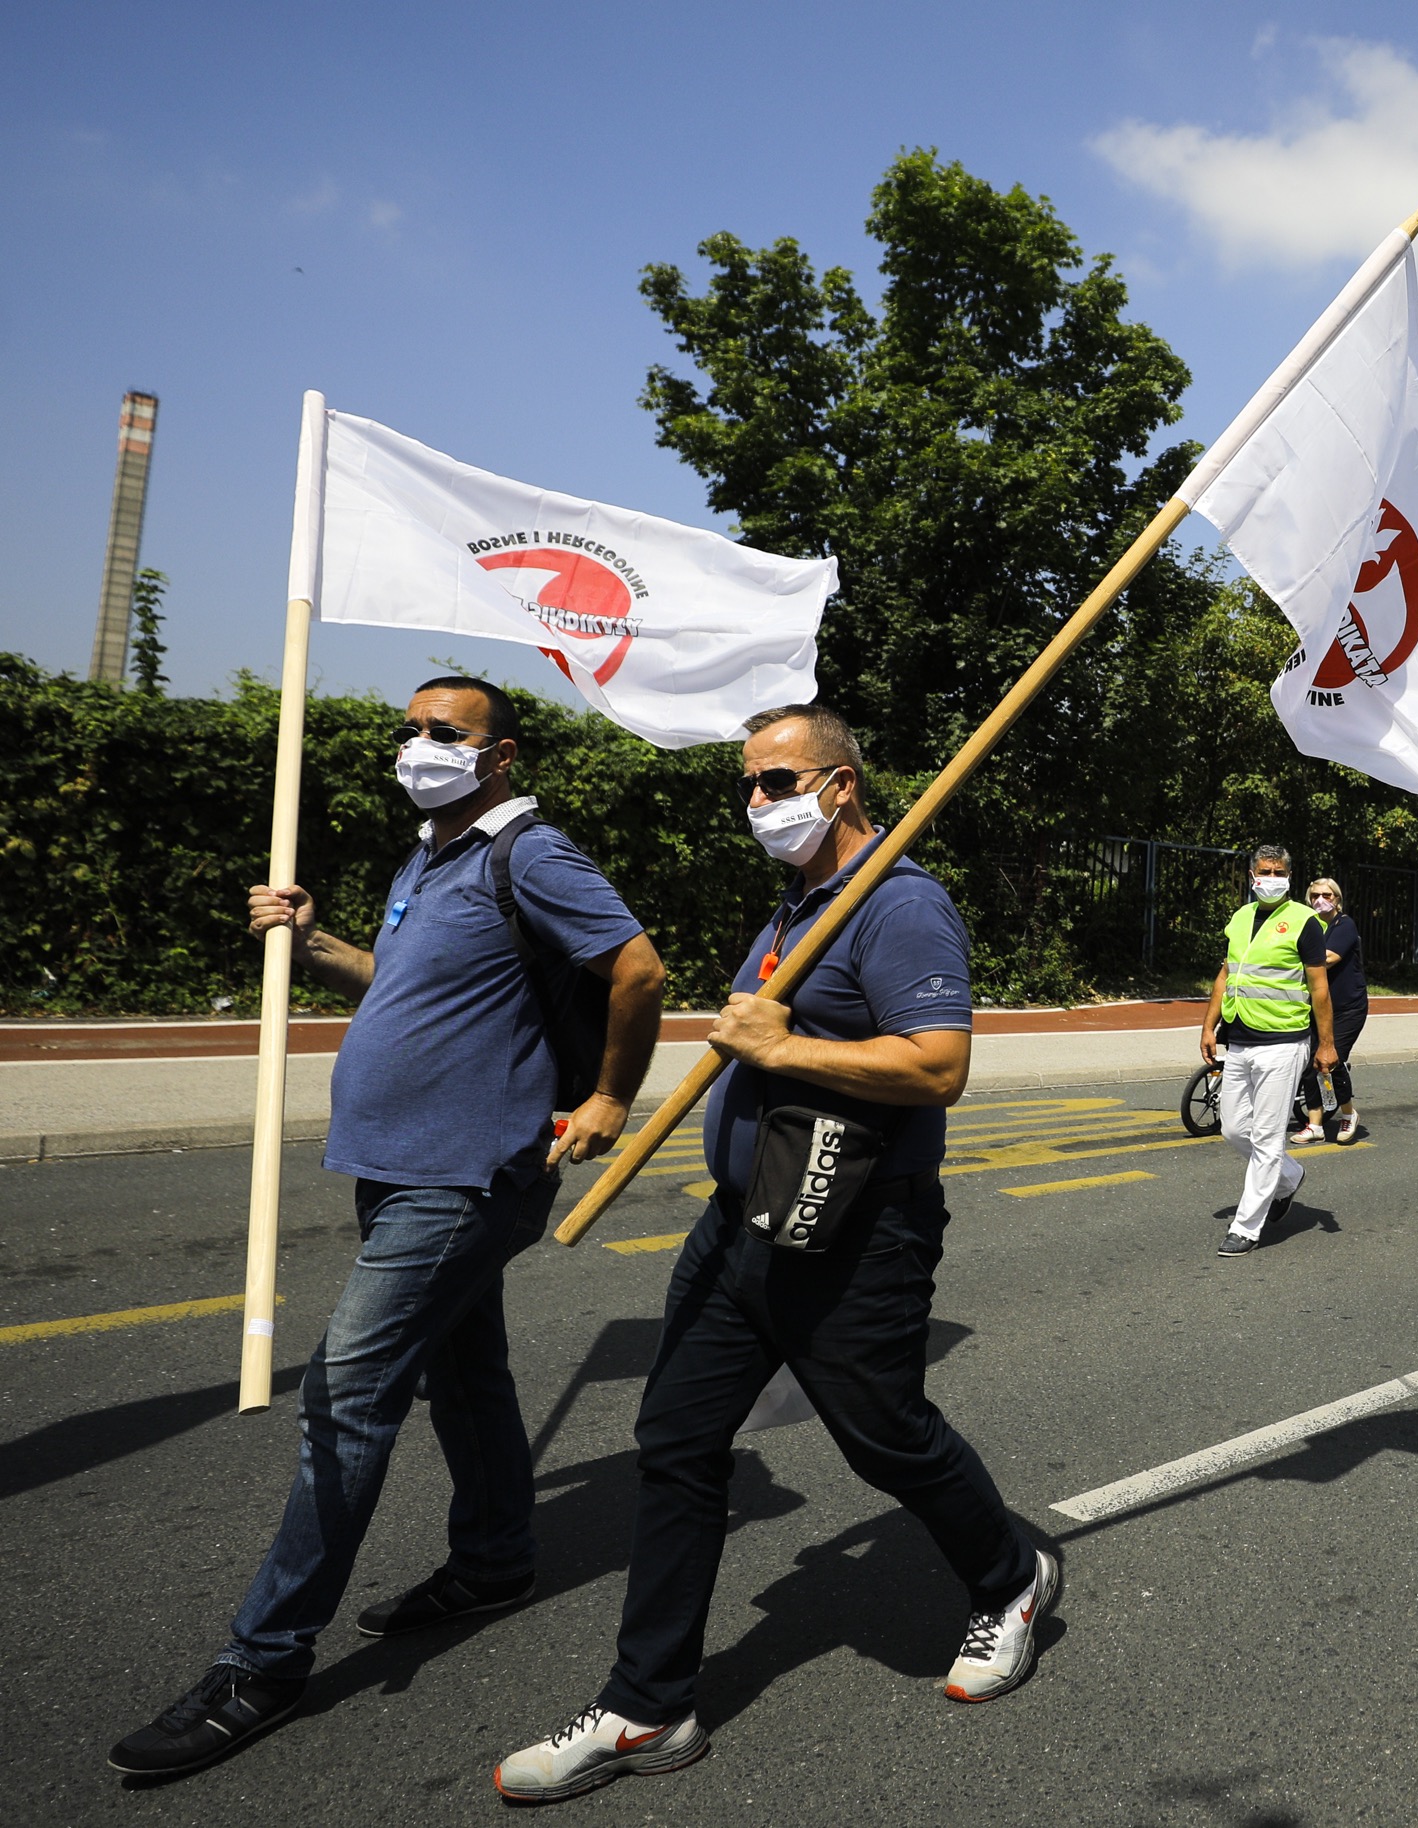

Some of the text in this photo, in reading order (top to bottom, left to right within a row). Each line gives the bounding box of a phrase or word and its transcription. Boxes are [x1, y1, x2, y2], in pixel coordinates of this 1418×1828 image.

[781, 811, 813, 825] SSS BiH
[789, 1131, 843, 1242] adidas
